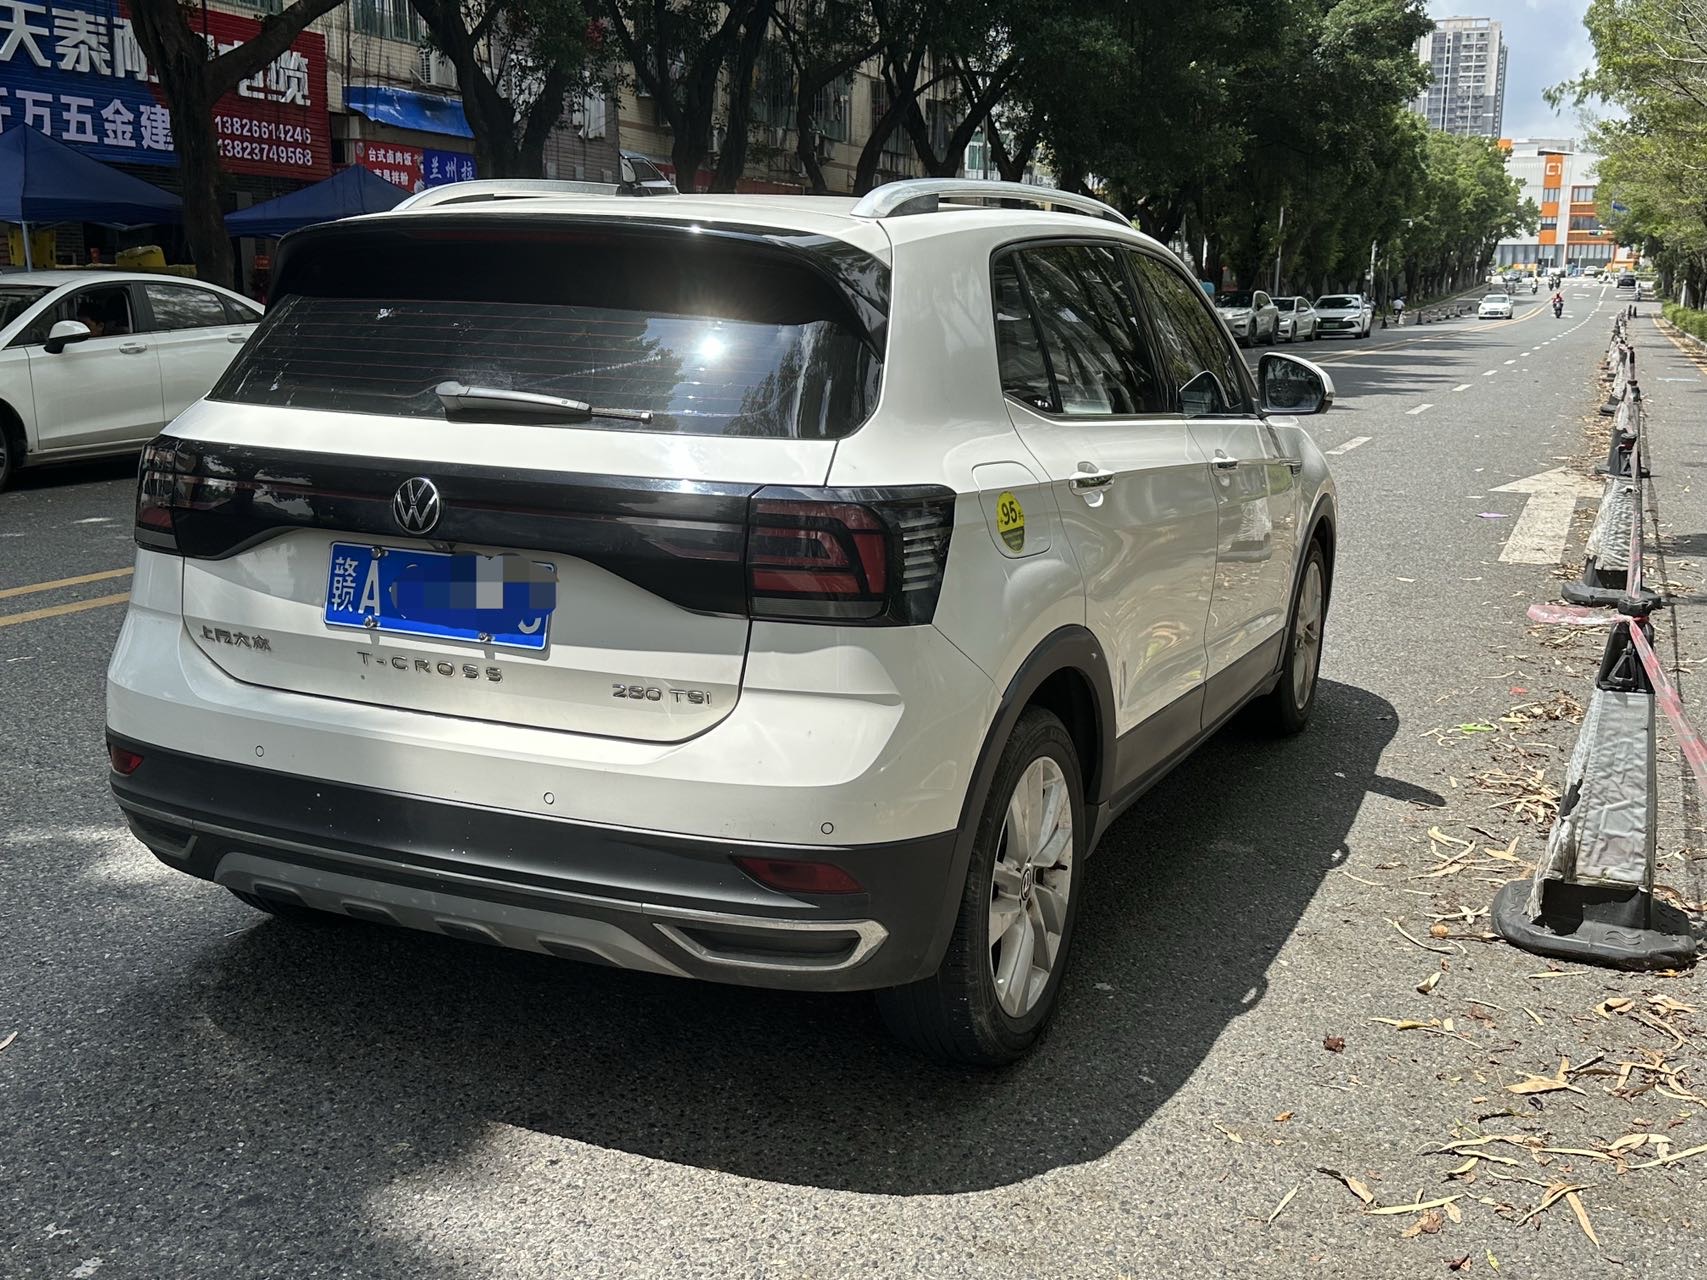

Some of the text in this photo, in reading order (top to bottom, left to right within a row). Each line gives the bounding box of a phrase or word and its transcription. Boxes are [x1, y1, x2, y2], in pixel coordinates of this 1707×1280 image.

[214, 115, 312, 145] 13826614246
[217, 138, 313, 167] 13823749568
[368, 147, 412, 166] 台式卤肉饭
[1001, 501, 1018, 525] 95
[357, 651, 504, 683] T-CROSS
[612, 683, 712, 706] 280 TSI
